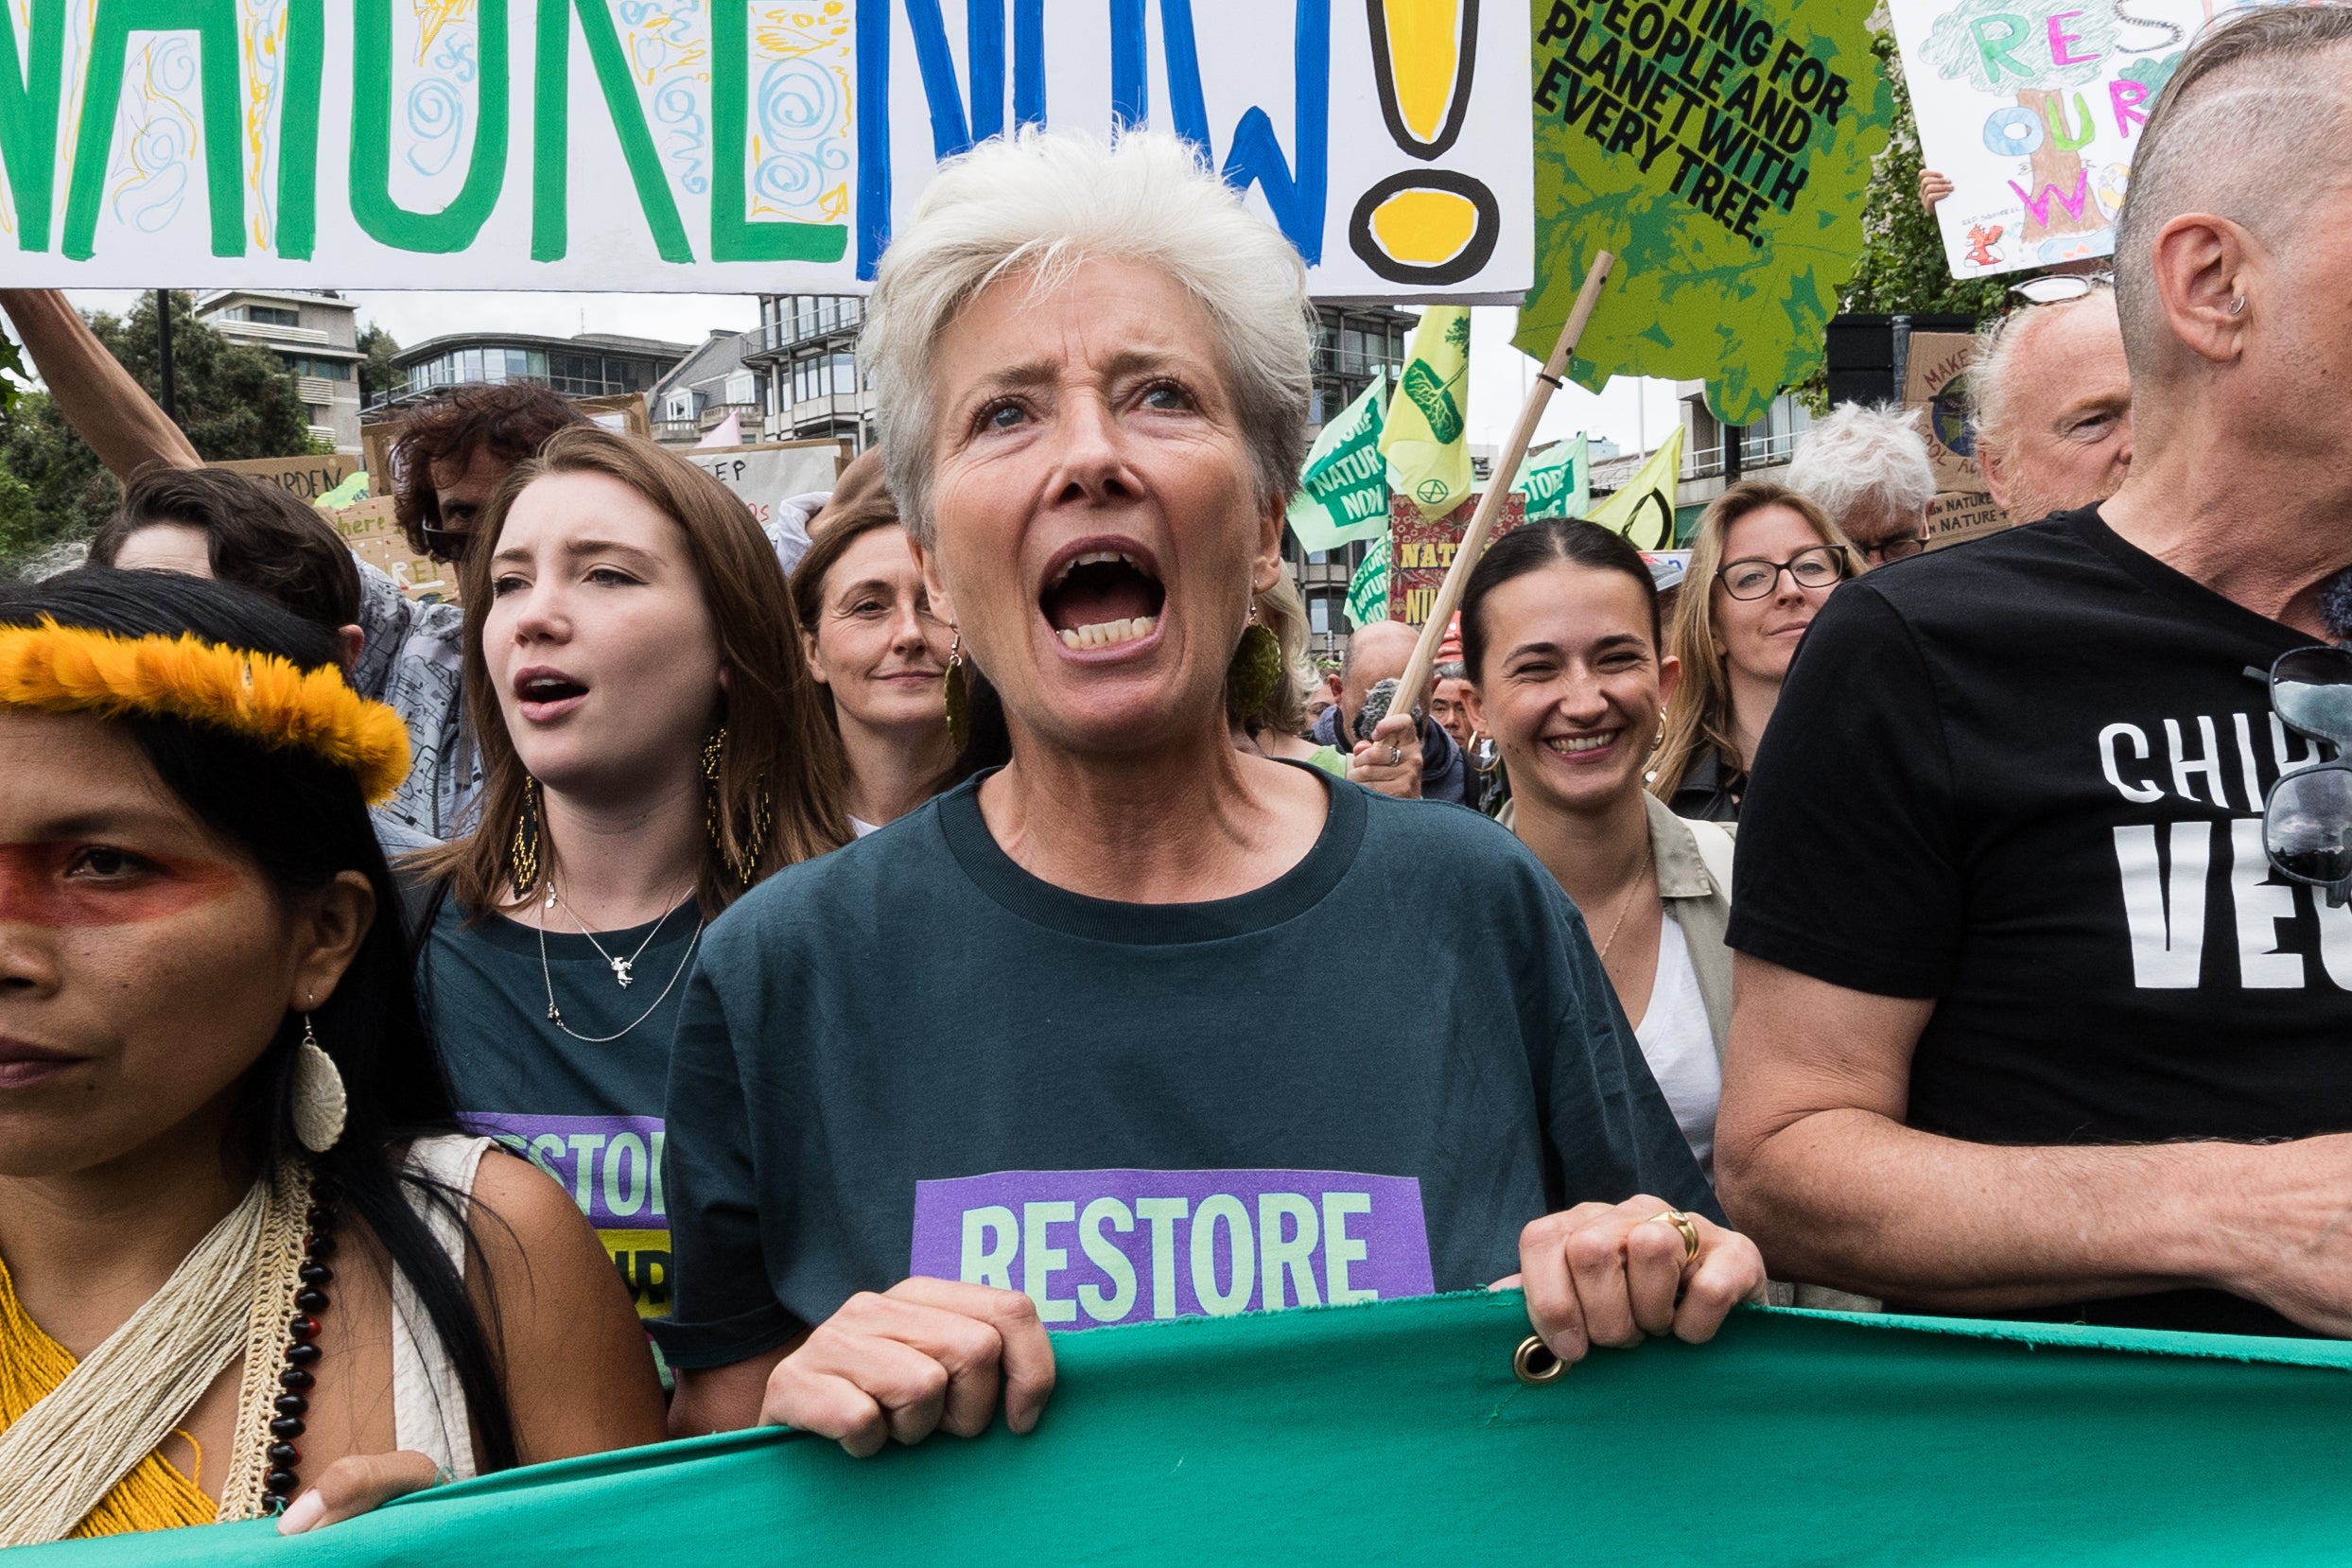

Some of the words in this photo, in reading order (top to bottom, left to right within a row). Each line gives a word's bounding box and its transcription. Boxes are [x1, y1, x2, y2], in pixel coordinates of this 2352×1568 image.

[1537, 2, 1702, 135] PLANET
[1699, 104, 1809, 213] WITH
[1577, 0, 1735, 102] EOPLE
[1722, 74, 1812, 154] AND
[1768, 39, 1849, 126] FOR
[1983, 79, 2150, 156] OUR
[1533, 58, 1676, 174] EVERY
[1668, 144, 1769, 248] TREE.
[1923, 349, 1969, 391] MAKE
[1340, 483, 1385, 519] NOW
[1941, 509, 1996, 531] NATURE
[1946, 494, 1995, 512] NATURE
[492, 1131, 667, 1217] STO
[961, 1192, 1379, 1322] RESTORE
